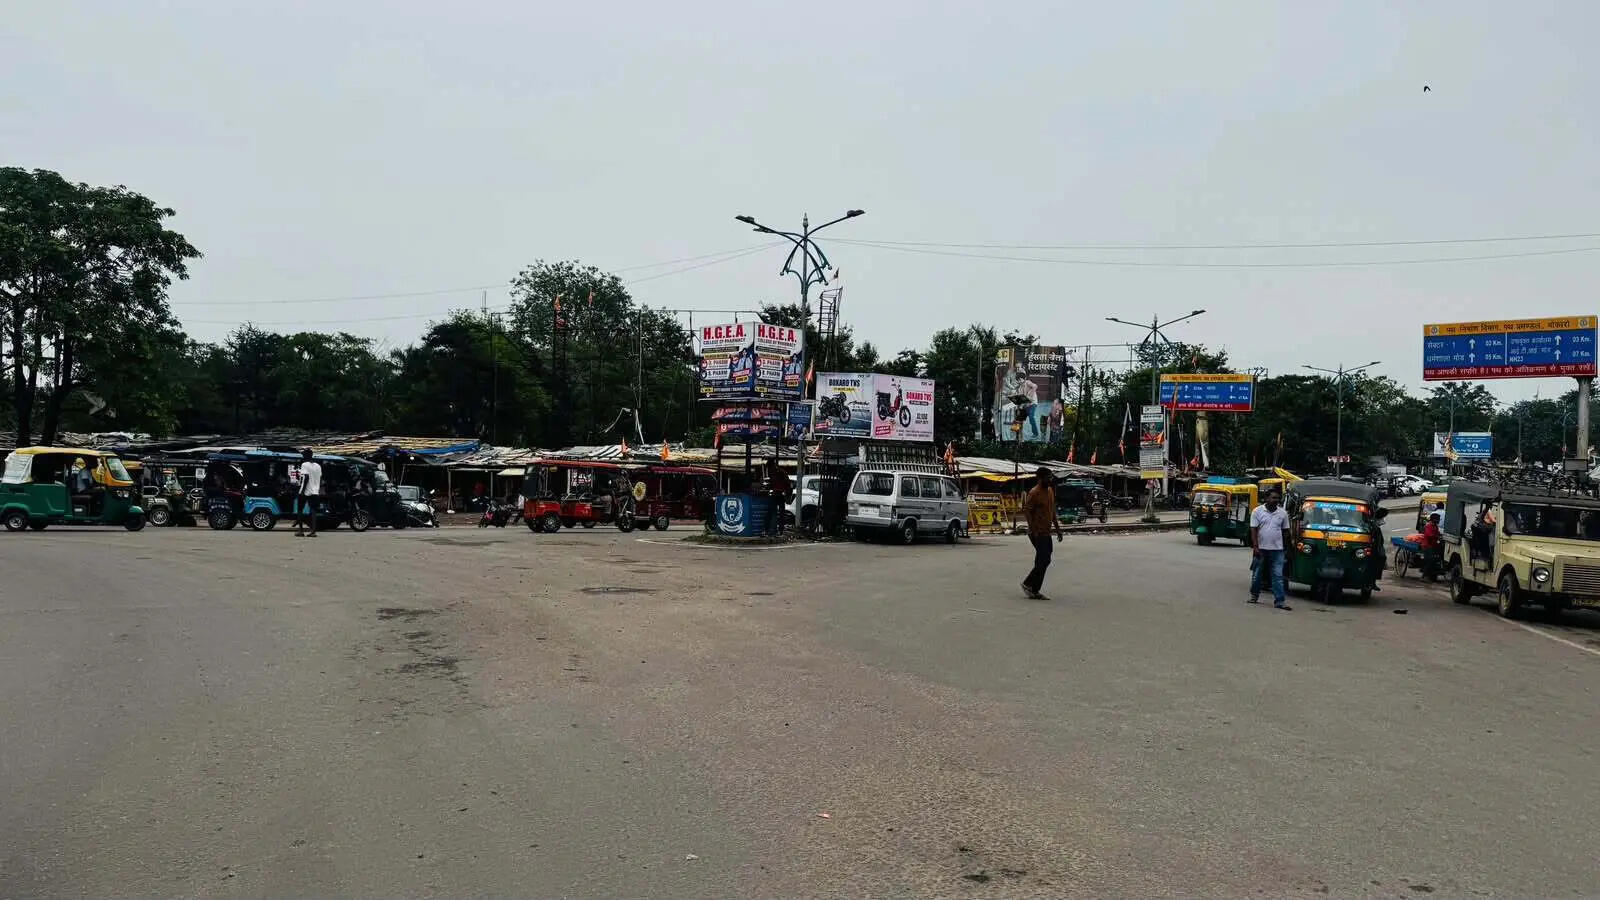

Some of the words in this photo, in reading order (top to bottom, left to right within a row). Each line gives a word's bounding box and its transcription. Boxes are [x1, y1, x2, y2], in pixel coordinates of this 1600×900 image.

[703, 324, 747, 340] H.G.E.A.
[757, 324, 798, 343] H.G.E.A.
[829, 379, 849, 387] BOKARO
[850, 379, 861, 387] TVS
